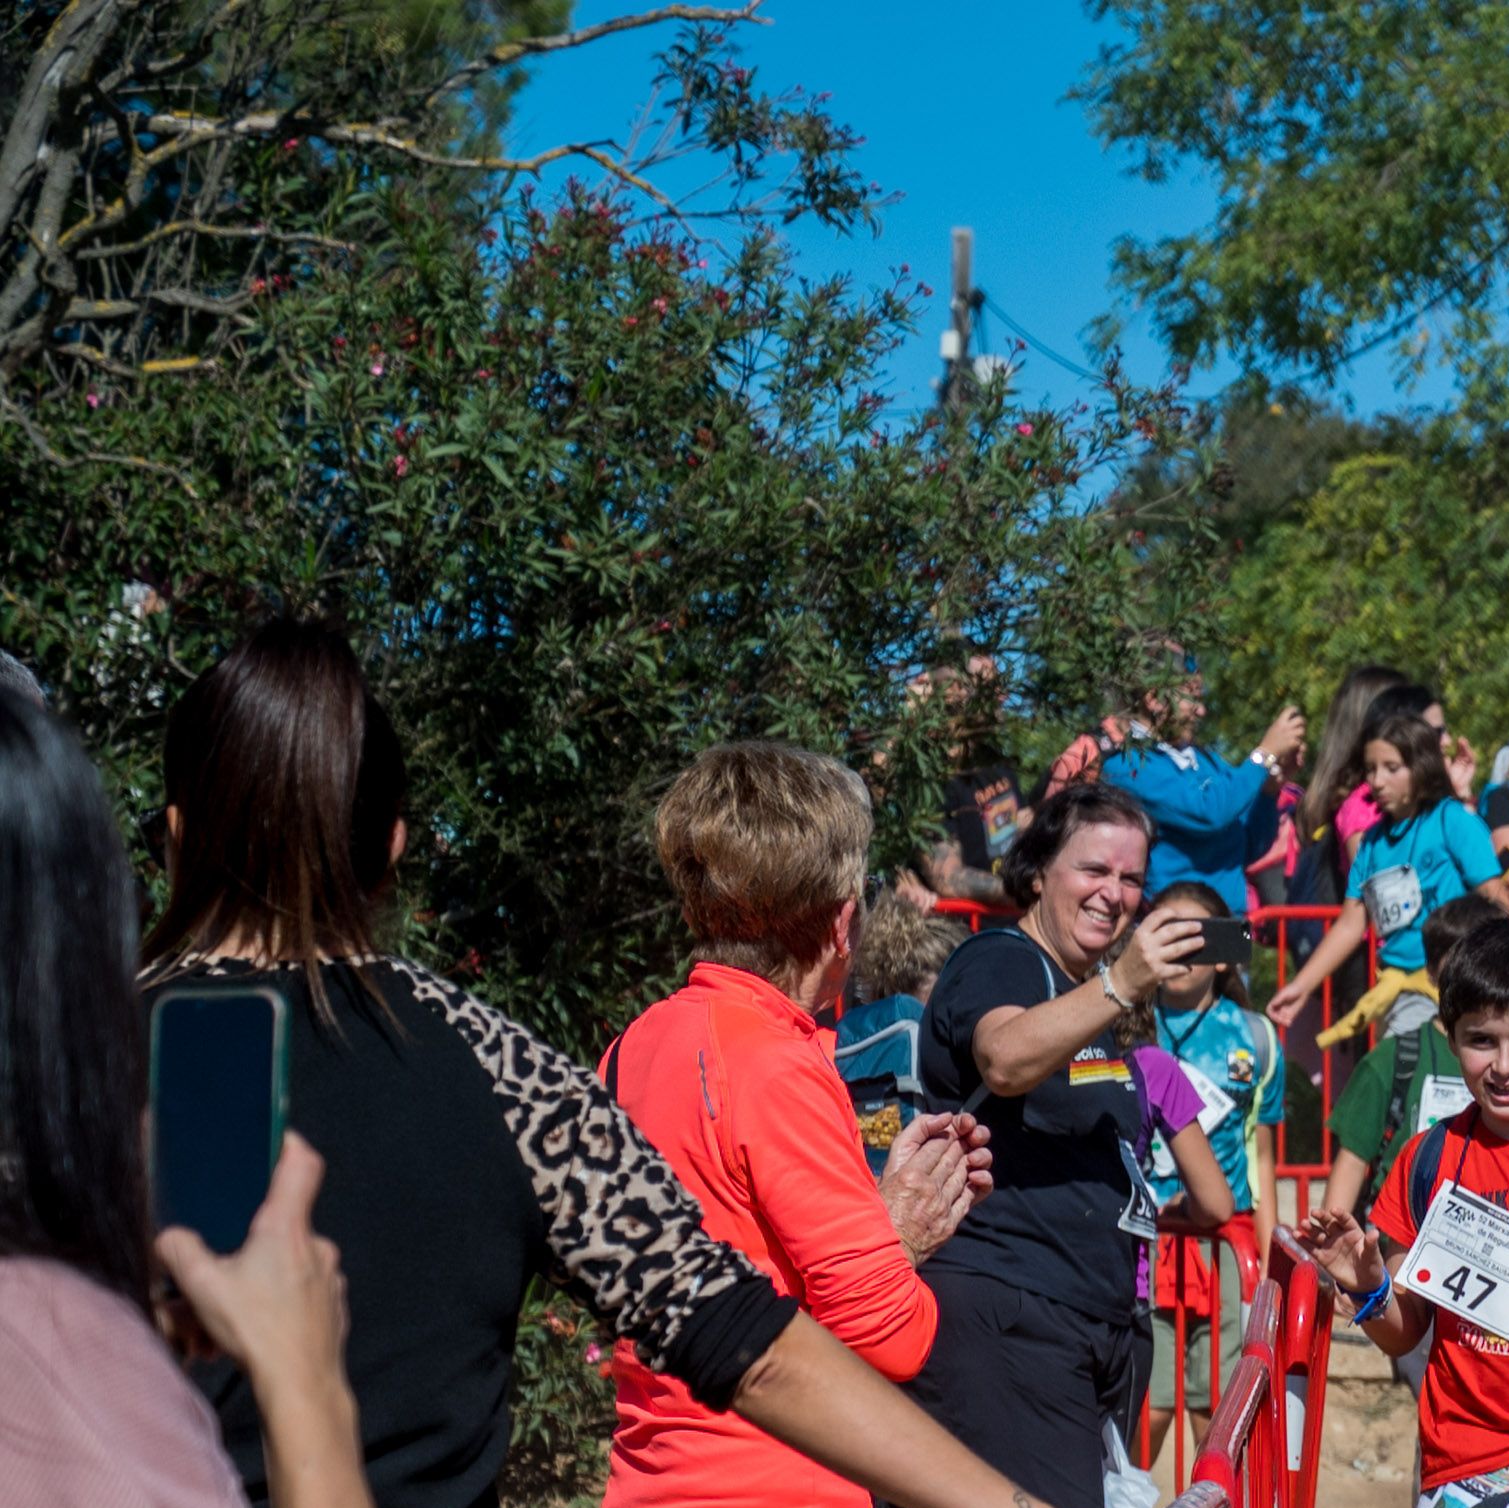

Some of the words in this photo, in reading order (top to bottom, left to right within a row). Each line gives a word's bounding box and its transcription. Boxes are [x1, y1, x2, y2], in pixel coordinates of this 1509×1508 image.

[1478, 1214, 1488, 1224] 52
[1477, 1227, 1487, 1237] de
[1442, 1265, 1497, 1311] 47
